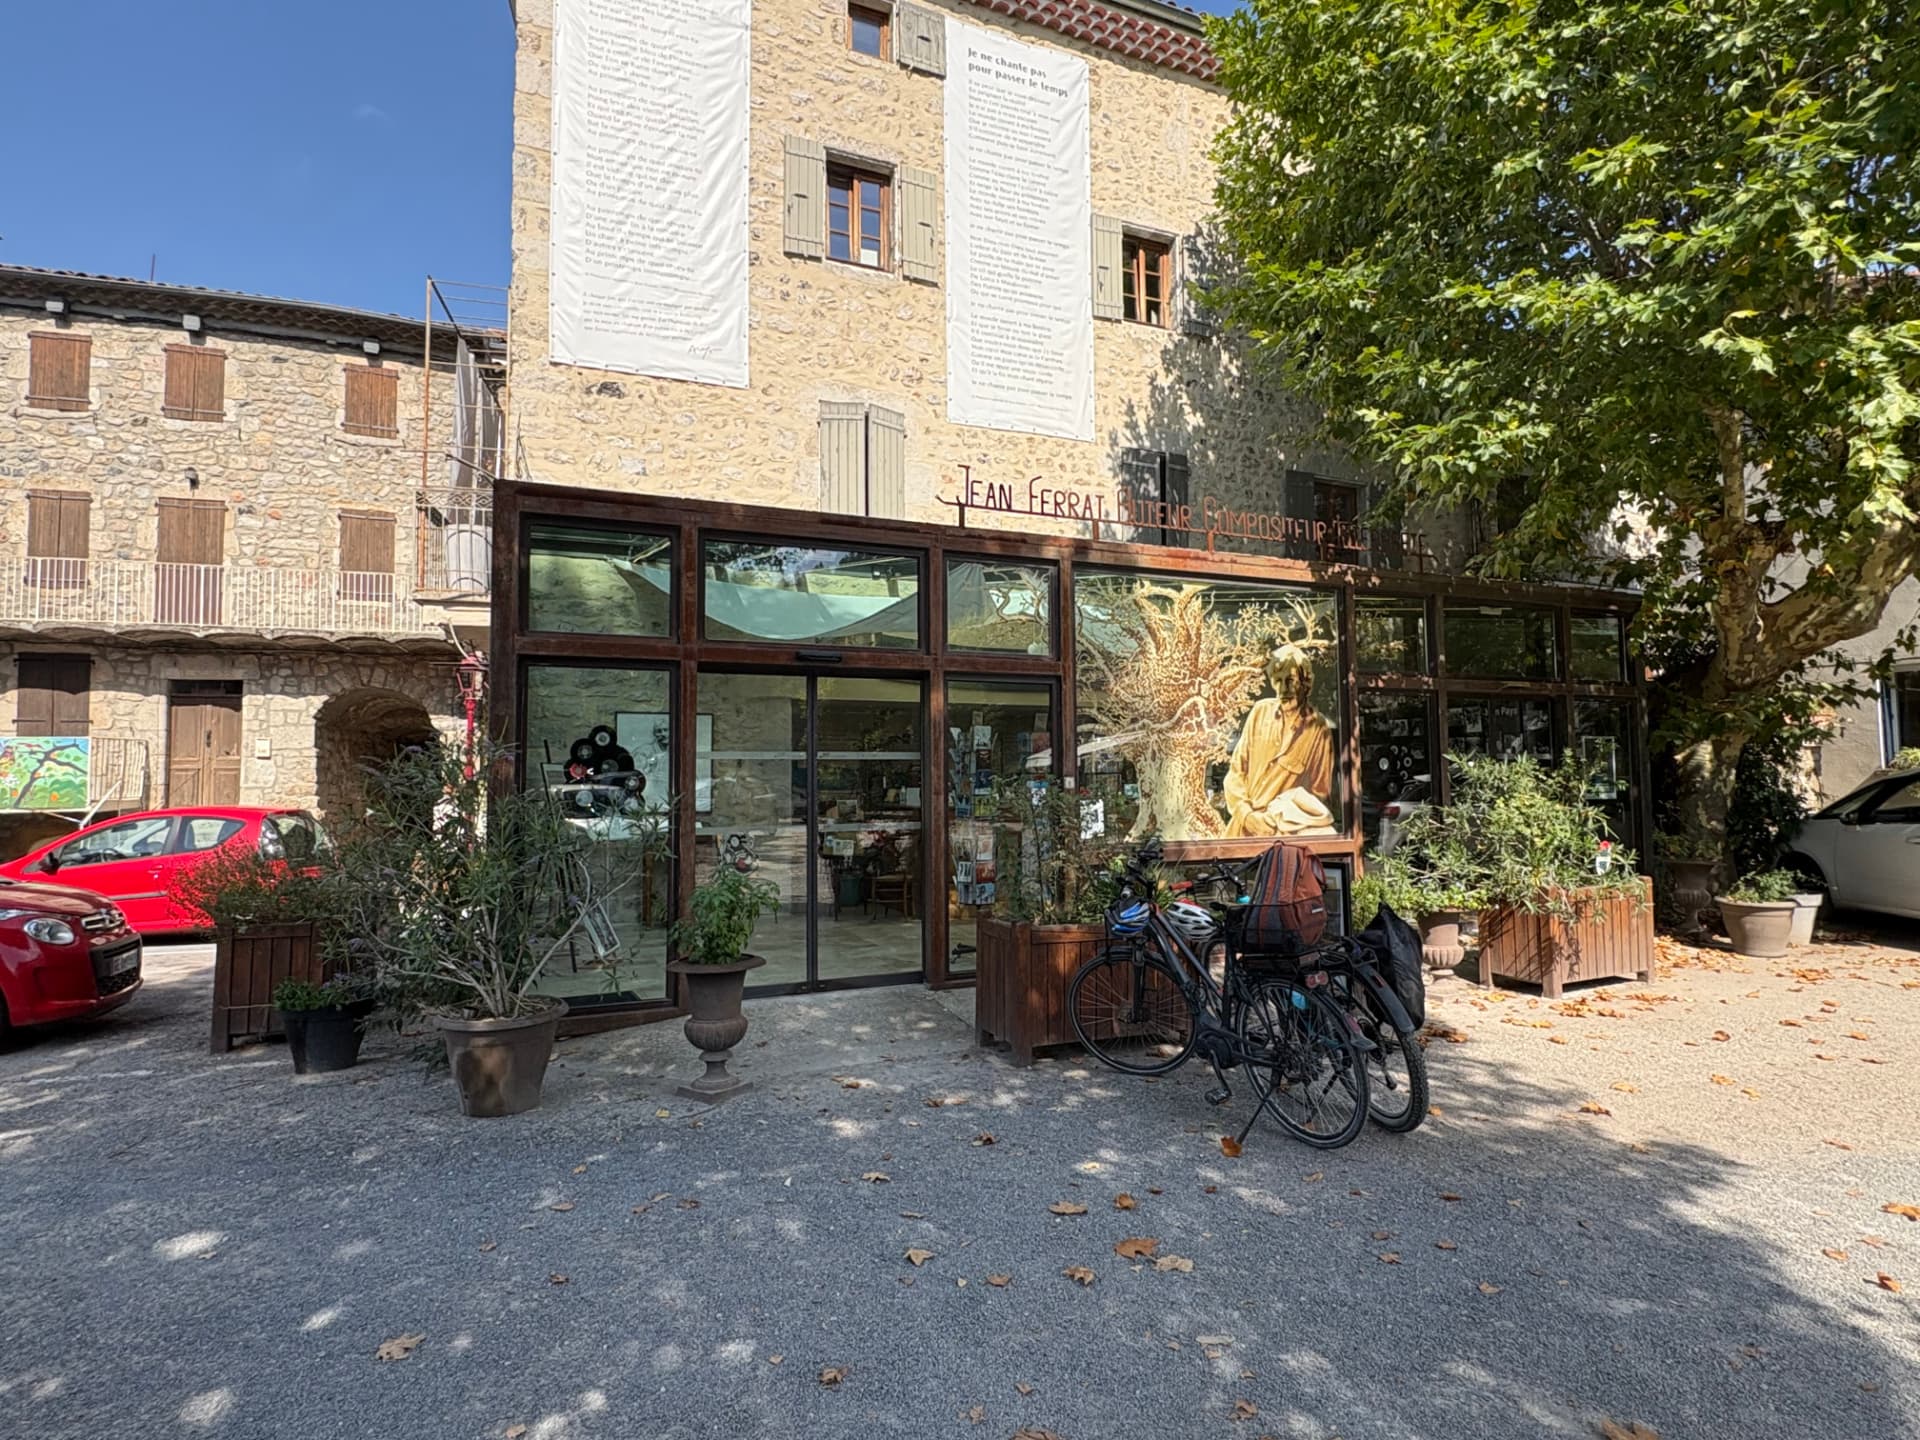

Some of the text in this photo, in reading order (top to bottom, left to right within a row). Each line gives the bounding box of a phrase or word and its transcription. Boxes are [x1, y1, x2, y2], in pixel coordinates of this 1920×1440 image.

[967, 47, 1046, 79] Je ne chante pas
[968, 62, 1068, 98] pour passer le temps
[957, 464, 1012, 510] JEAN
[1029, 475, 1105, 521] FERRAT
[1117, 485, 1192, 530] AUTEUR
[1203, 495, 1326, 545] COMPOSITEUR
